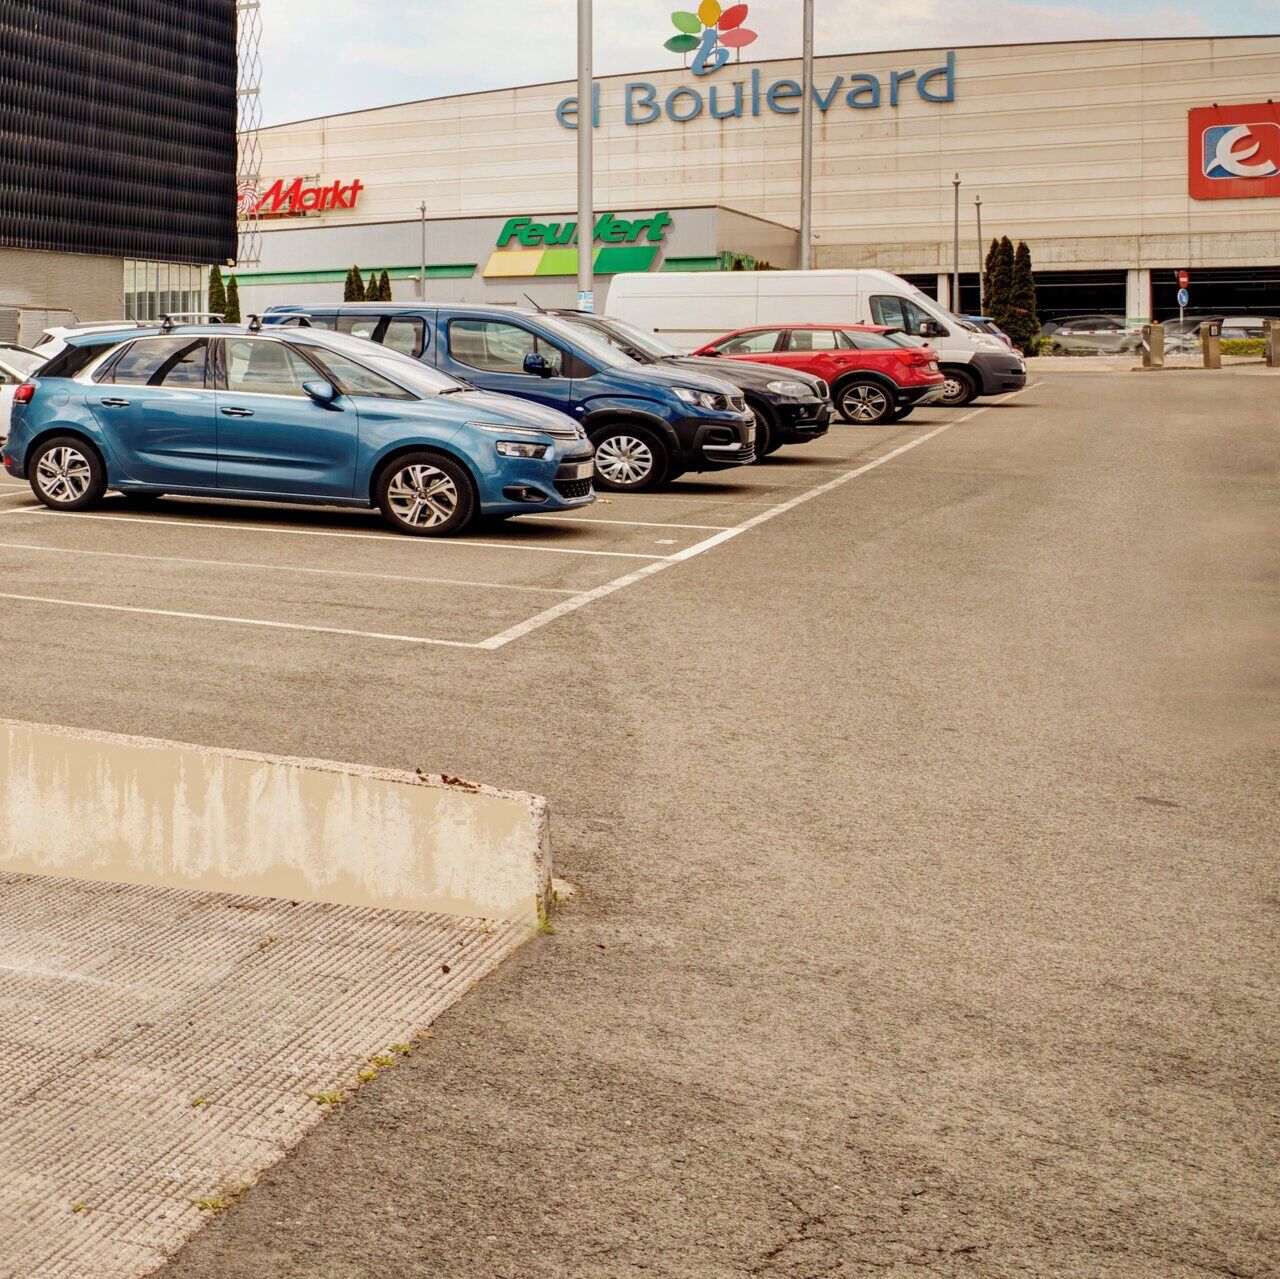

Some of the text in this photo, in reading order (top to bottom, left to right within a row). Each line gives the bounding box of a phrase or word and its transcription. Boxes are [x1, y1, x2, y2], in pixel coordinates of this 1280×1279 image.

[555, 51, 956, 129] el Boulevard
[250, 177, 364, 212] Markt
